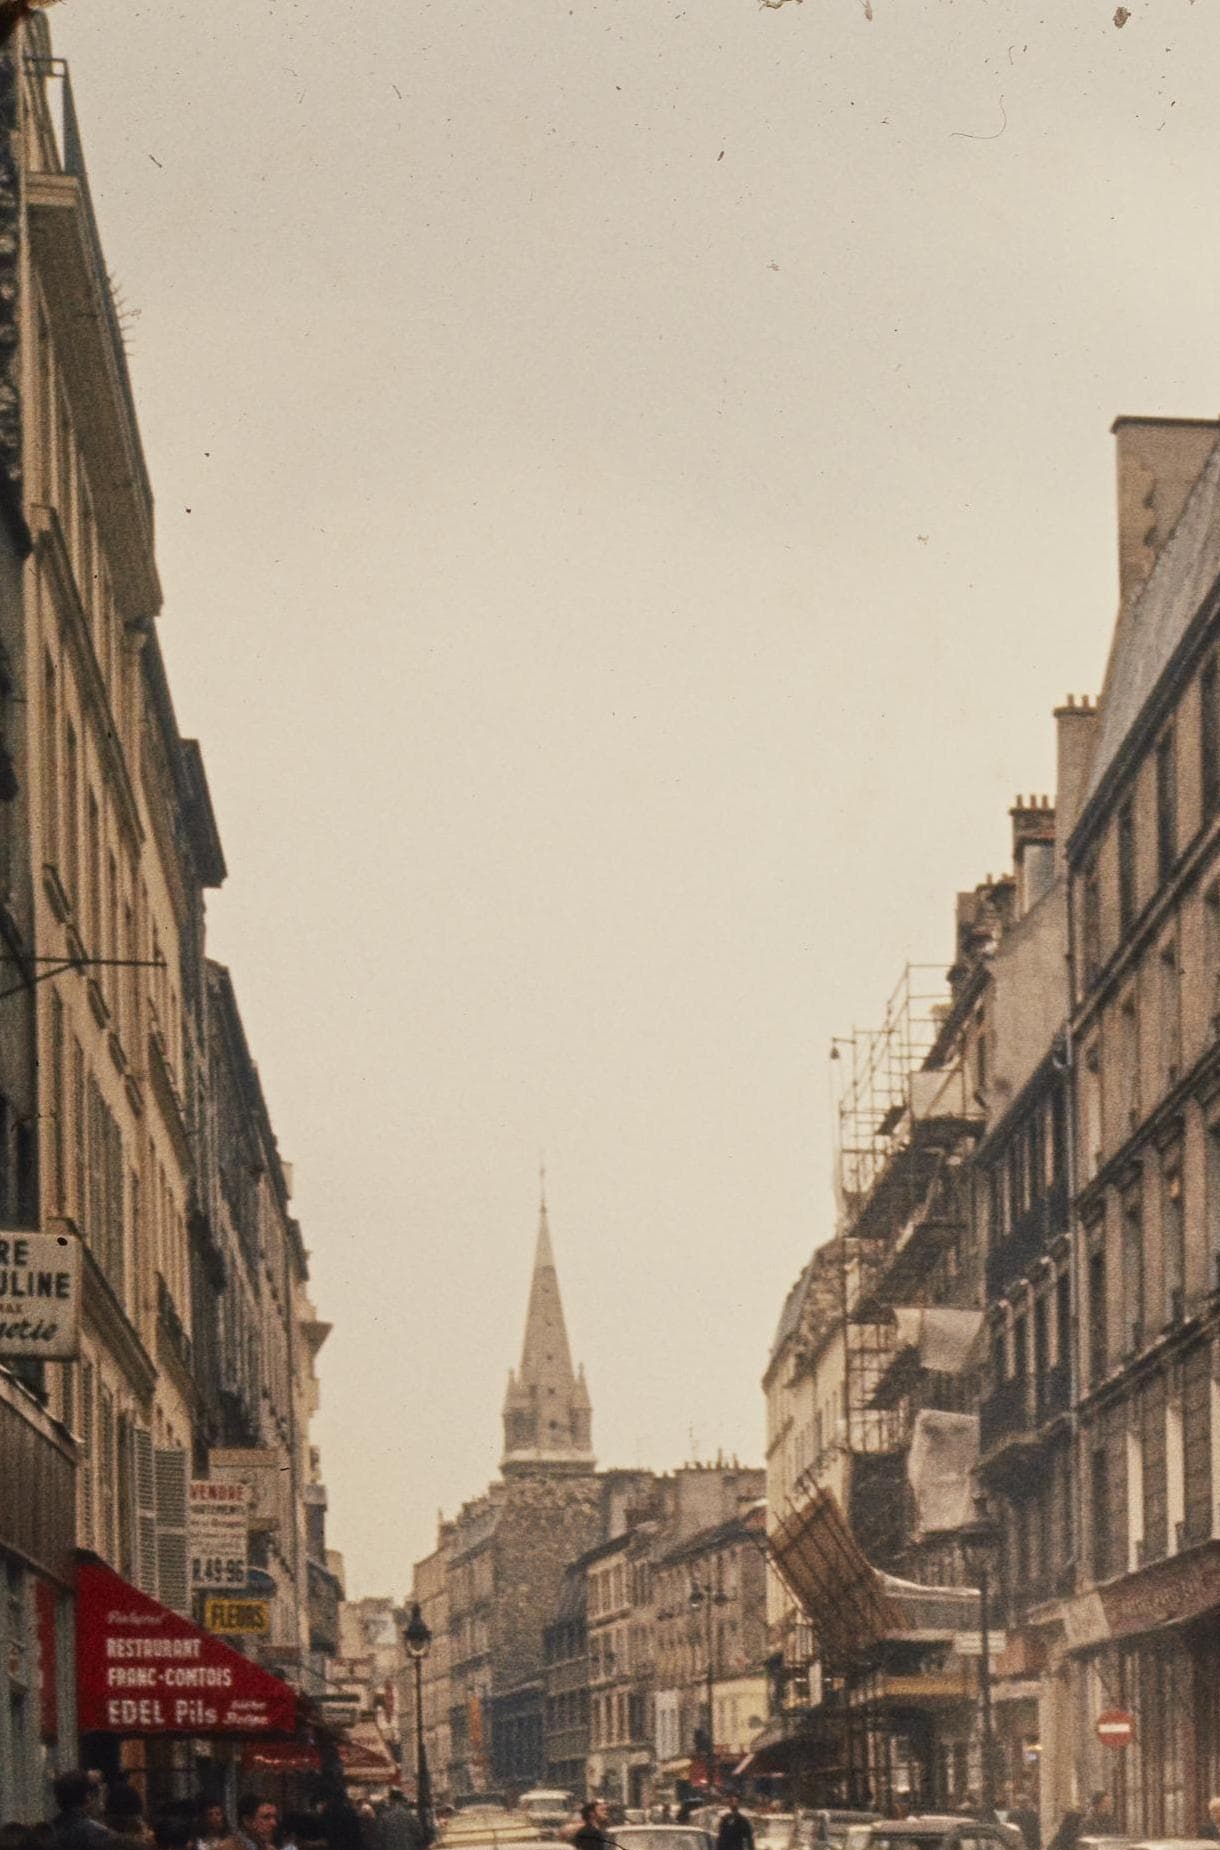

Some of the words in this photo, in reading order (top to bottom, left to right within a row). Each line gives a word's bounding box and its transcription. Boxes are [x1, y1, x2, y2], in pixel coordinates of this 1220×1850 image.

[106, 1638, 202, 1659] RESTAURANT
[108, 1699, 165, 1725] EDEL
[175, 1699, 218, 1725] Pils
